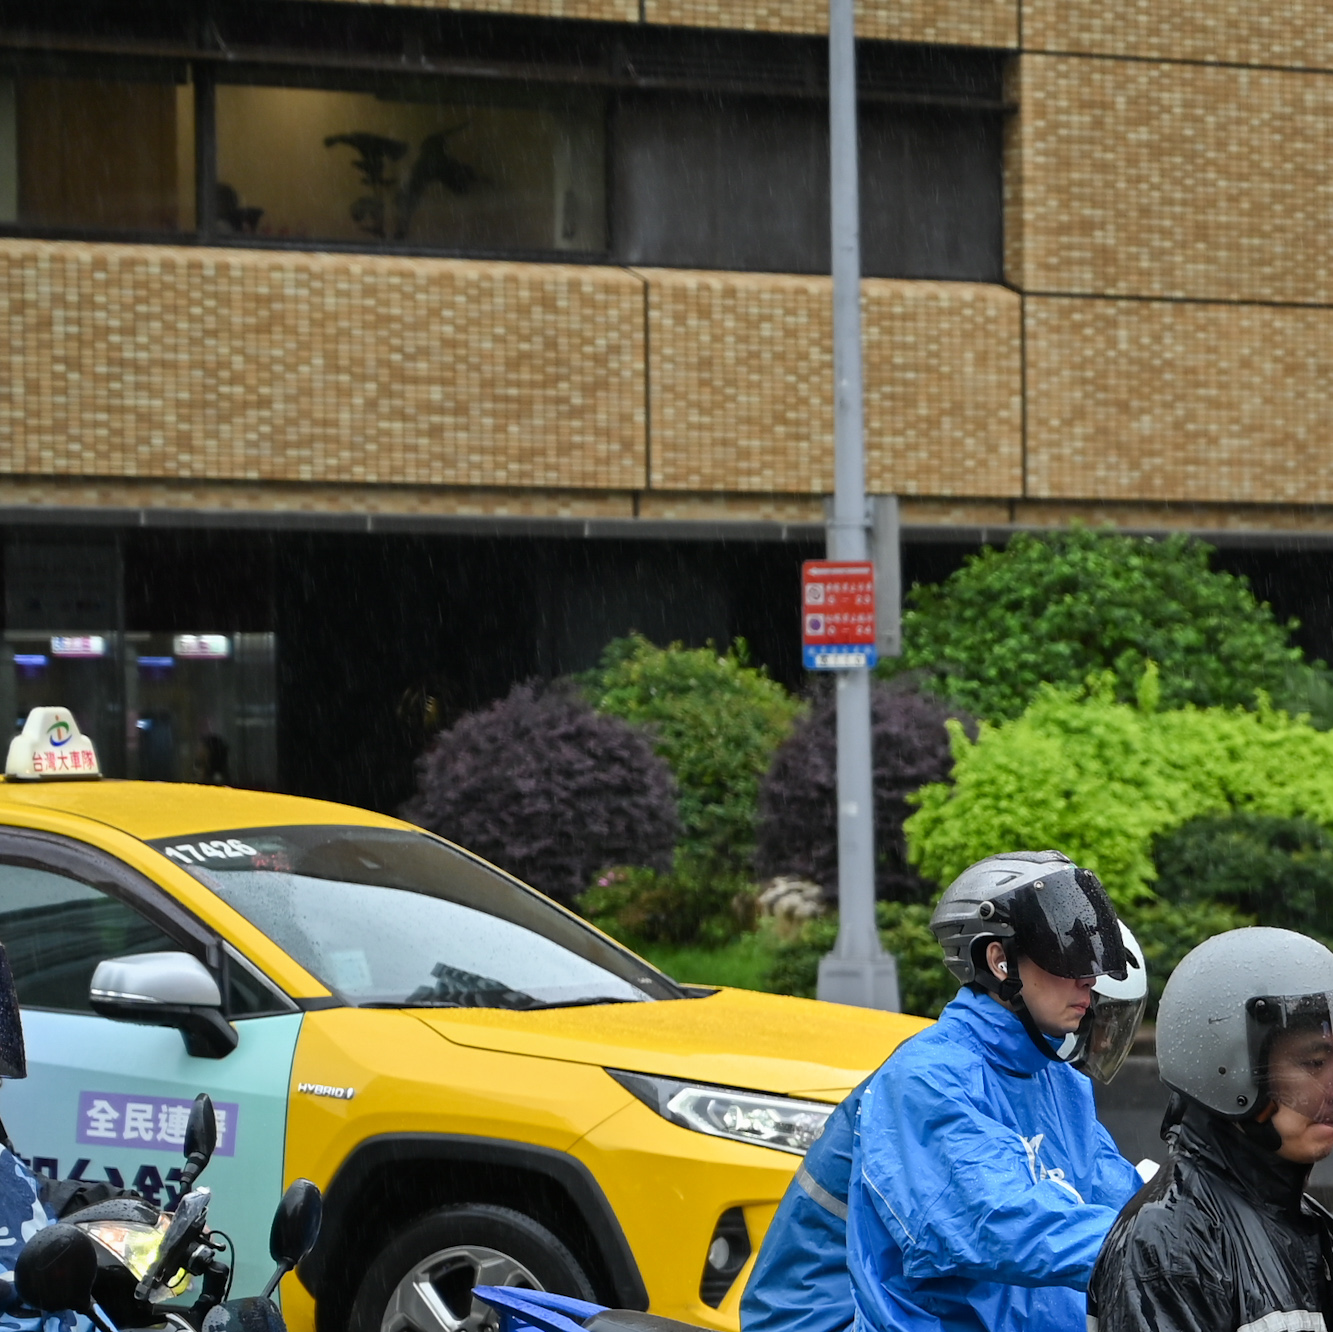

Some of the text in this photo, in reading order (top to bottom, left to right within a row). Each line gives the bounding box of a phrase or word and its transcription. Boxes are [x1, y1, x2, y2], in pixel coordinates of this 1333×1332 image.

[32, 750, 95, 773] 台灣大車隊
[164, 838, 258, 864] 17426
[298, 1083, 344, 1098] HYBRID
